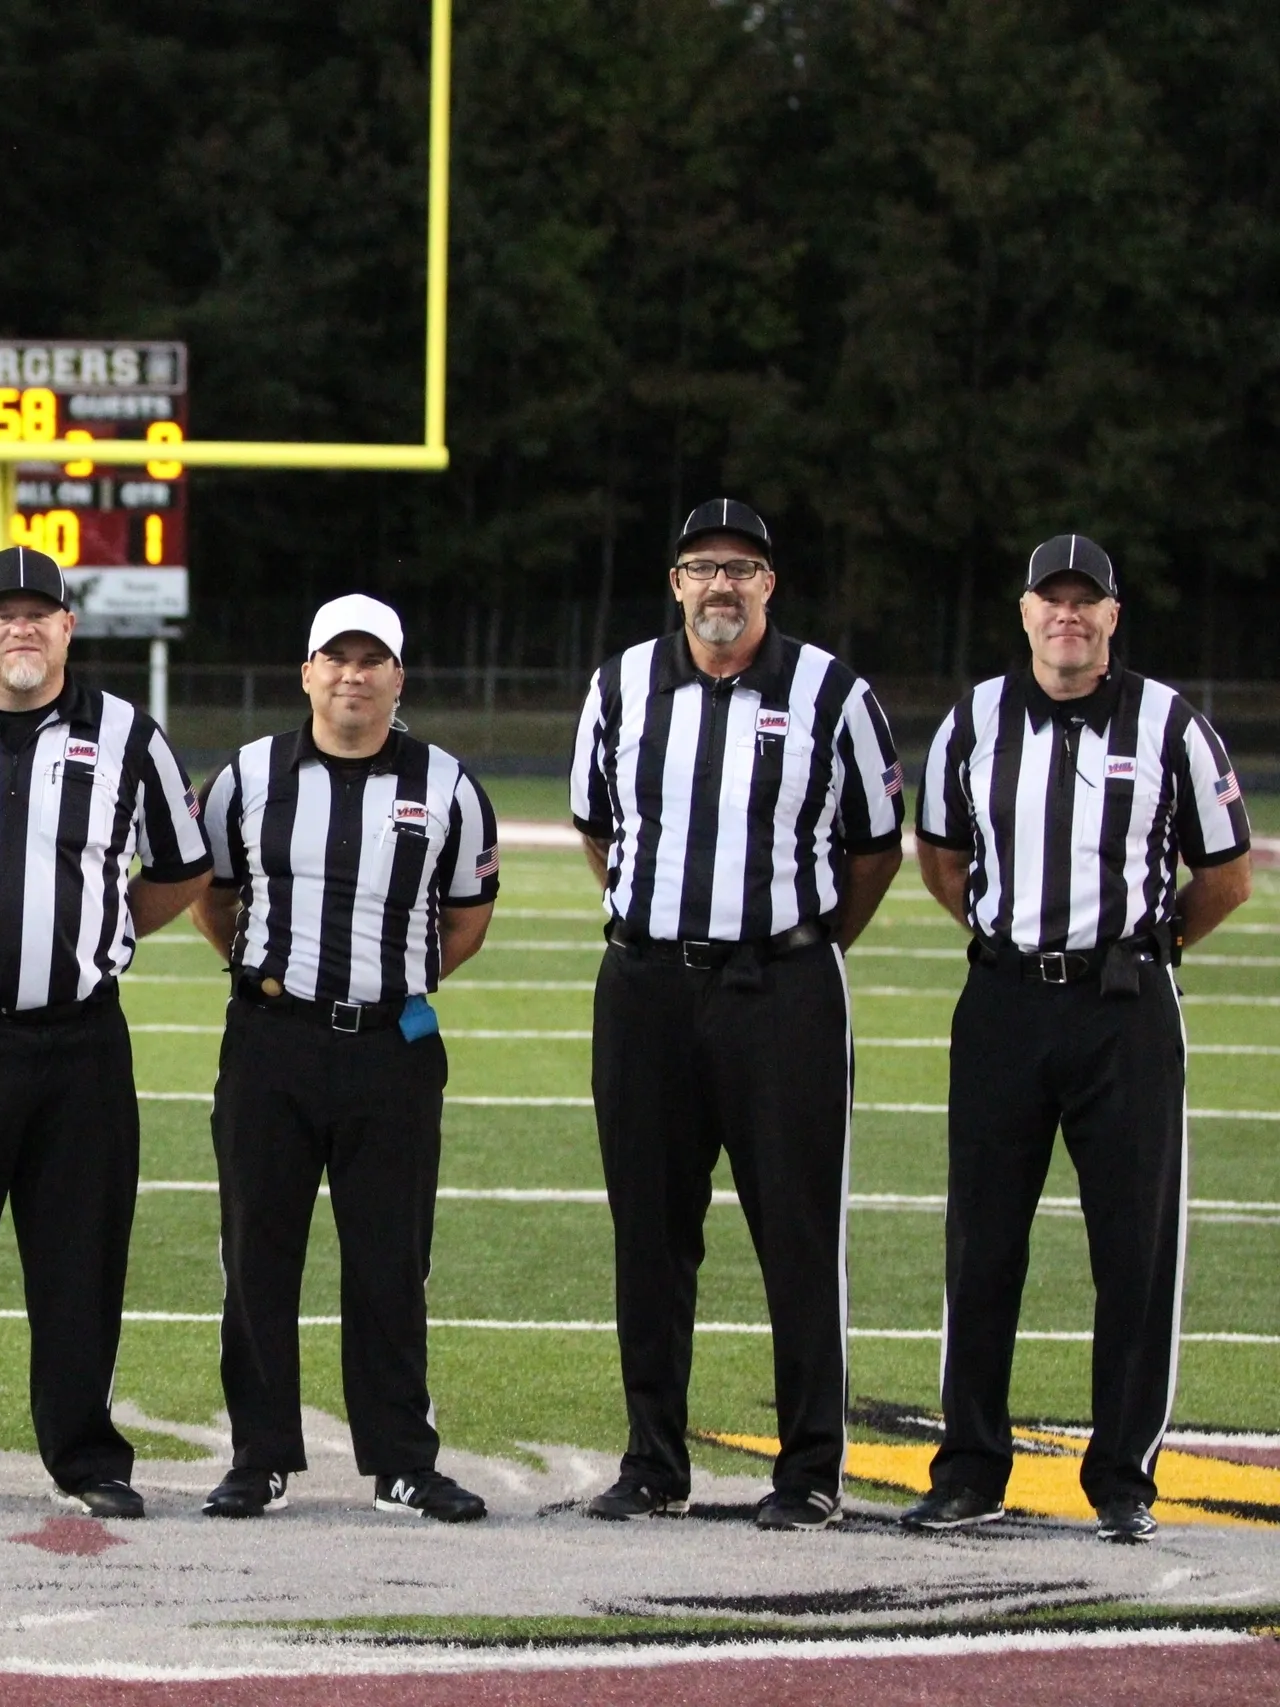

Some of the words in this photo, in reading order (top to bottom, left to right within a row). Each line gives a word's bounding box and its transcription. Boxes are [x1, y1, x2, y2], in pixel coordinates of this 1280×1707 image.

[69, 395, 173, 418] GUESTS
[16, 482, 54, 505] ALL
[57, 482, 93, 506] ON
[120, 483, 172, 507] QTR
[9, 509, 80, 567] 40
[145, 514, 163, 565] 1
[760, 716, 787, 727] VHSL
[68, 745, 96, 756] VHSL
[1108, 761, 1133, 772] VHSL
[397, 807, 426, 818] VHSL
